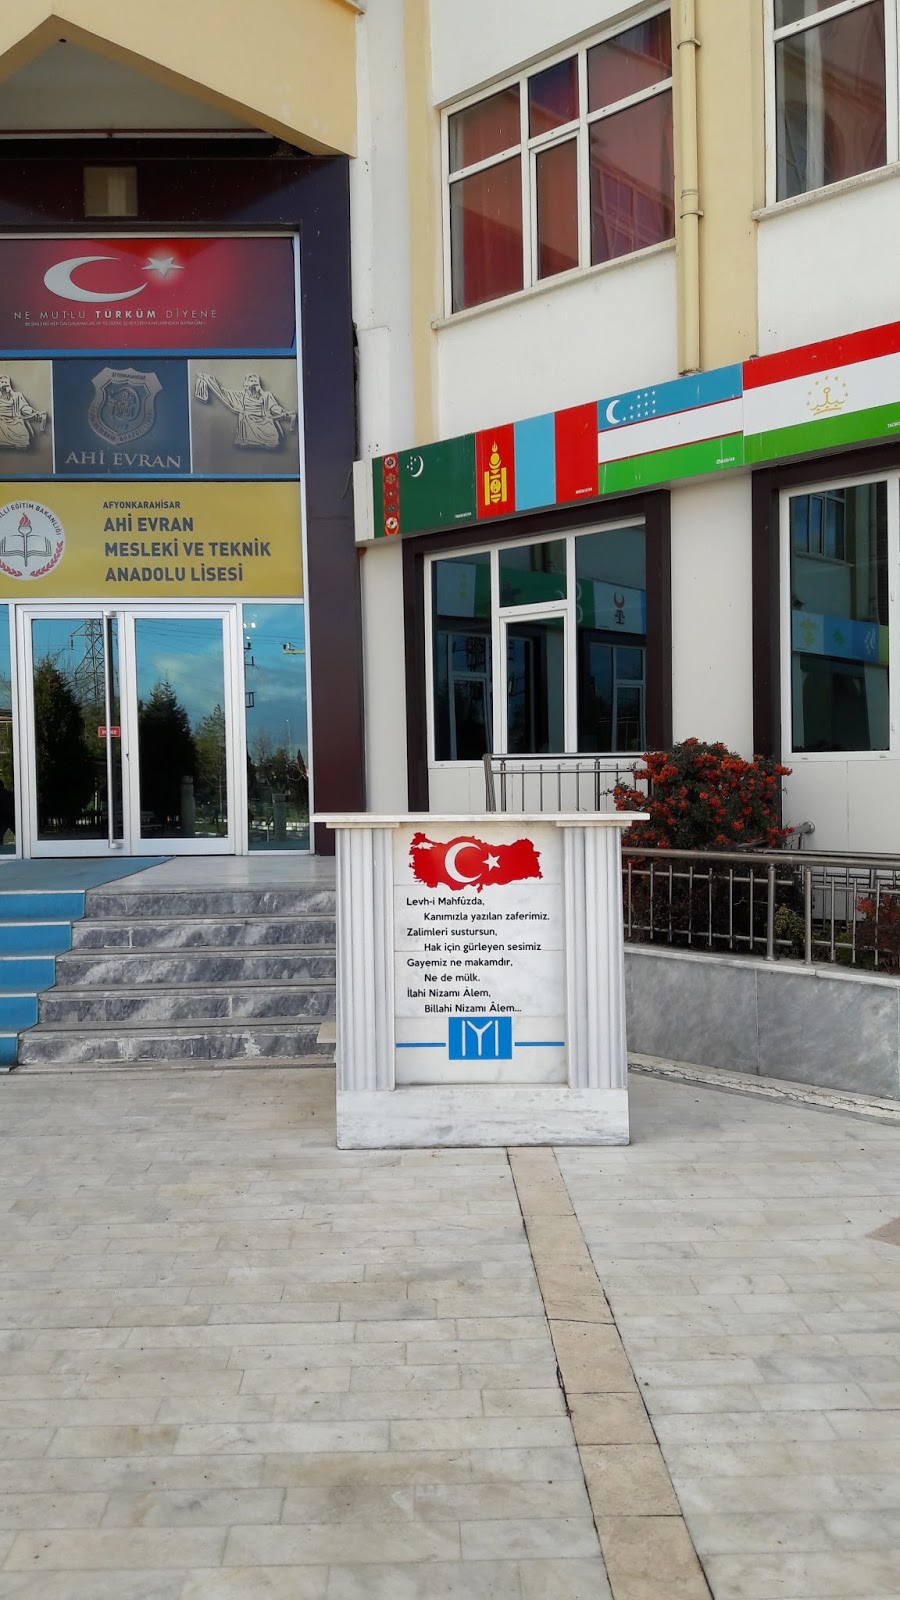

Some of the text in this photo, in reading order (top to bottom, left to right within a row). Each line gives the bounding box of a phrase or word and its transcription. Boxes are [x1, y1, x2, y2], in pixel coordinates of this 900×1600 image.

[14, 311, 30, 320] NE
[95, 308, 157, 319] TÜRKÜM
[165, 308, 218, 319] DİYENE
[64, 449, 182, 469] AHİ EVRAN
[103, 499, 181, 509] AFYONKARAHİSAR
[11, 502, 34, 510] EĞİTİM
[36, 505, 63, 535] BAKANLIĞI
[104, 513, 194, 532] AHİ EVRAN
[104, 538, 272, 557] MESLEKİ VE TEKNİK
[105, 563, 243, 582] ANADOLU LİSESİ
[406, 896, 436, 906] Levh-i
[424, 911, 550, 924] Kanımızla yazılan zaferimiz.
[406, 926, 498, 938] Zalimleri sustursun,
[424, 941, 542, 954] Hak için gürleyen sesimiz
[406, 957, 513, 970] Gayemiz ne makamdır,
[424, 972, 481, 983] Ne de mülk.
[428, 988, 461, 998] Nizamı
[424, 1003, 453, 1013] Billahi
[454, 1003, 487, 1013] Nizamı
